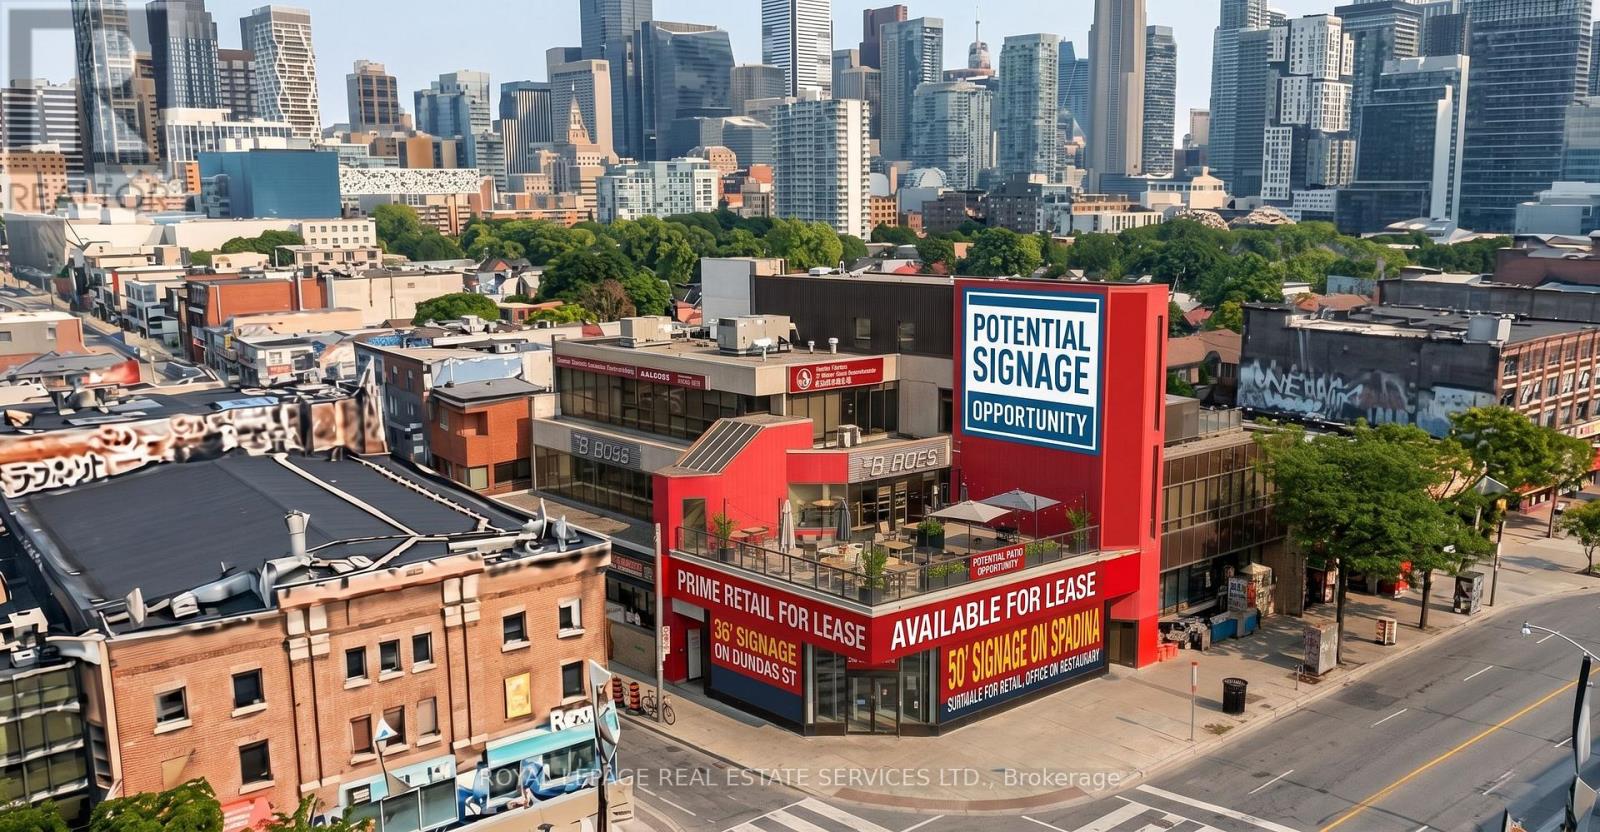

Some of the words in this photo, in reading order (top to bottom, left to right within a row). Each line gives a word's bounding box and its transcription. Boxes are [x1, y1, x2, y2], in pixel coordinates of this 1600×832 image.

[973, 313, 1091, 352] POTENTIAL
[973, 346, 1090, 395] SIGNAGE
[972, 399, 1087, 437] OPPORTUNITY
[972, 552, 1005, 567] POTENTIAL
[1006, 547, 1024, 560] PATIO
[977, 558, 1019, 576] OPPORTUNITY
[677, 569, 721, 604] PRIME
[724, 584, 775, 621] RETAIL
[778, 600, 809, 632] FOR
[813, 611, 866, 651] LEASE
[890, 595, 1001, 652] AVAILABLE
[1006, 586, 1041, 620] FOR
[1045, 571, 1097, 609] LEASE
[714, 618, 733, 642] 36'
[736, 626, 797, 667] SIGNAGE
[714, 642, 730, 663] ON
[732, 648, 780, 681] DUNDAS
[781, 666, 797, 687] ST
[948, 644, 969, 691] 50'
[972, 628, 1028, 683] SIGNAGE
[1030, 622, 1048, 664] ON
[1051, 607, 1100, 657] SPADINA
[984, 682, 999, 700] FOR
[1025, 664, 1049, 686] OFFICE
